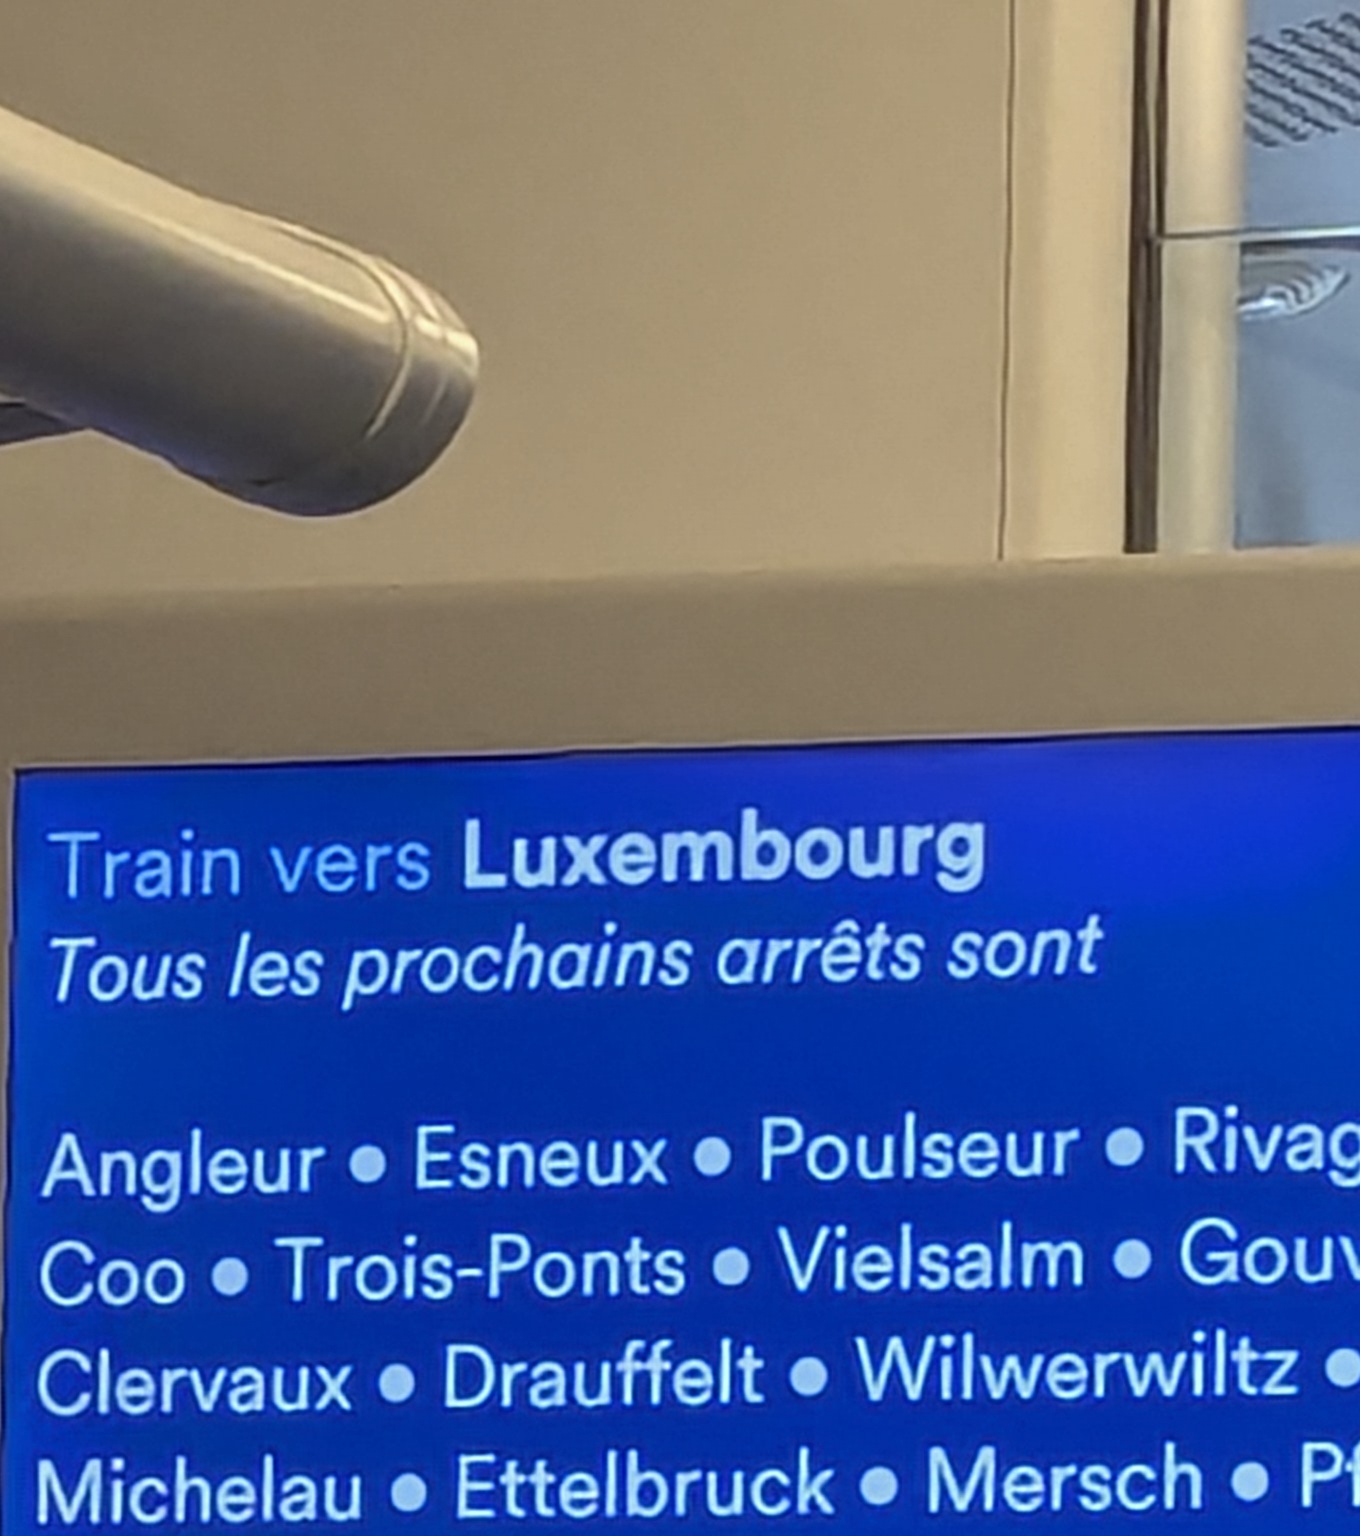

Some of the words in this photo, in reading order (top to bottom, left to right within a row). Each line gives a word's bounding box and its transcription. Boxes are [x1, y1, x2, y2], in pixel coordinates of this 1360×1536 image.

[48, 827, 241, 900] Train
[267, 835, 432, 894] vers
[464, 807, 985, 893] Luxembourg
[49, 936, 206, 1003] Tous
[229, 931, 324, 1001] les
[341, 921, 694, 1011] prochains
[717, 919, 926, 986] arrêts
[946, 914, 1105, 980] sont
[41, 1127, 326, 1213] Angleur
[416, 1124, 668, 1193] Esneux
[761, 1111, 1080, 1183] Poulseur
[39, 1239, 187, 1309] Coo
[274, 1232, 686, 1304] Trois-Ponts
[778, 1220, 1084, 1294] Vielsalm
[37, 1347, 352, 1418] Clervaux
[444, 1337, 765, 1411] Drauffelt
[855, 1328, 1299, 1404] Wilwerwiltz
[36, 1454, 362, 1527] Michelau
[457, 1446, 834, 1521] Ettelbruck
[928, 1441, 1203, 1515] Mersch
